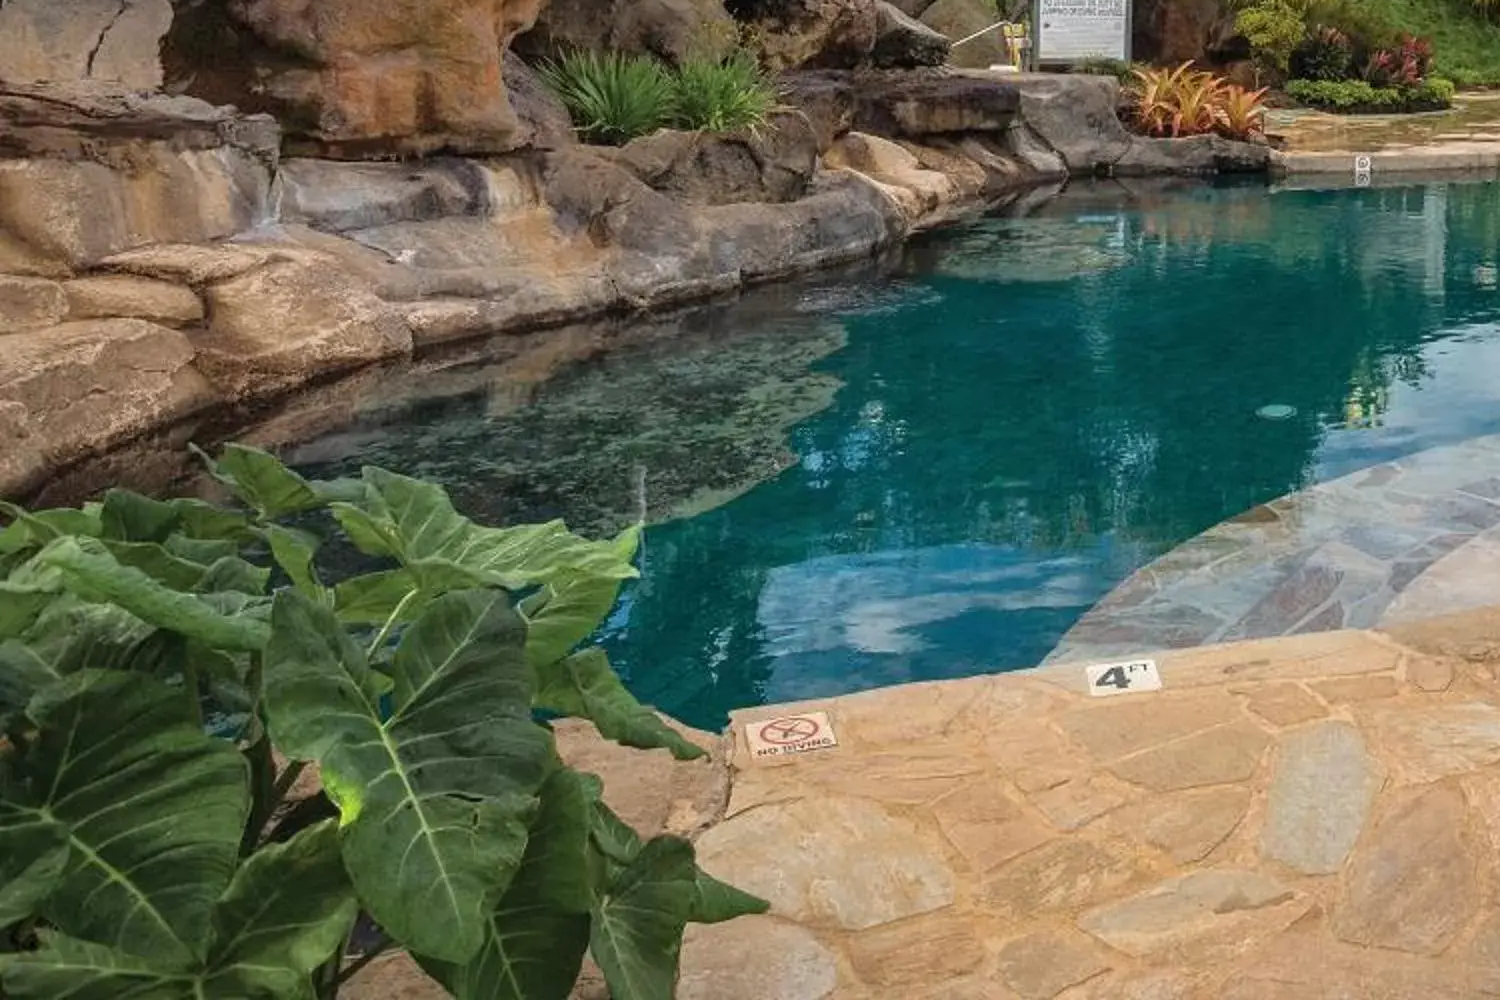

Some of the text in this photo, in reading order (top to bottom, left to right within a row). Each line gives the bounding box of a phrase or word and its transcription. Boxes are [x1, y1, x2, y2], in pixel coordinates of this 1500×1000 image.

[1096, 666, 1131, 688] 4
[757, 738, 832, 756] NO DIVING
